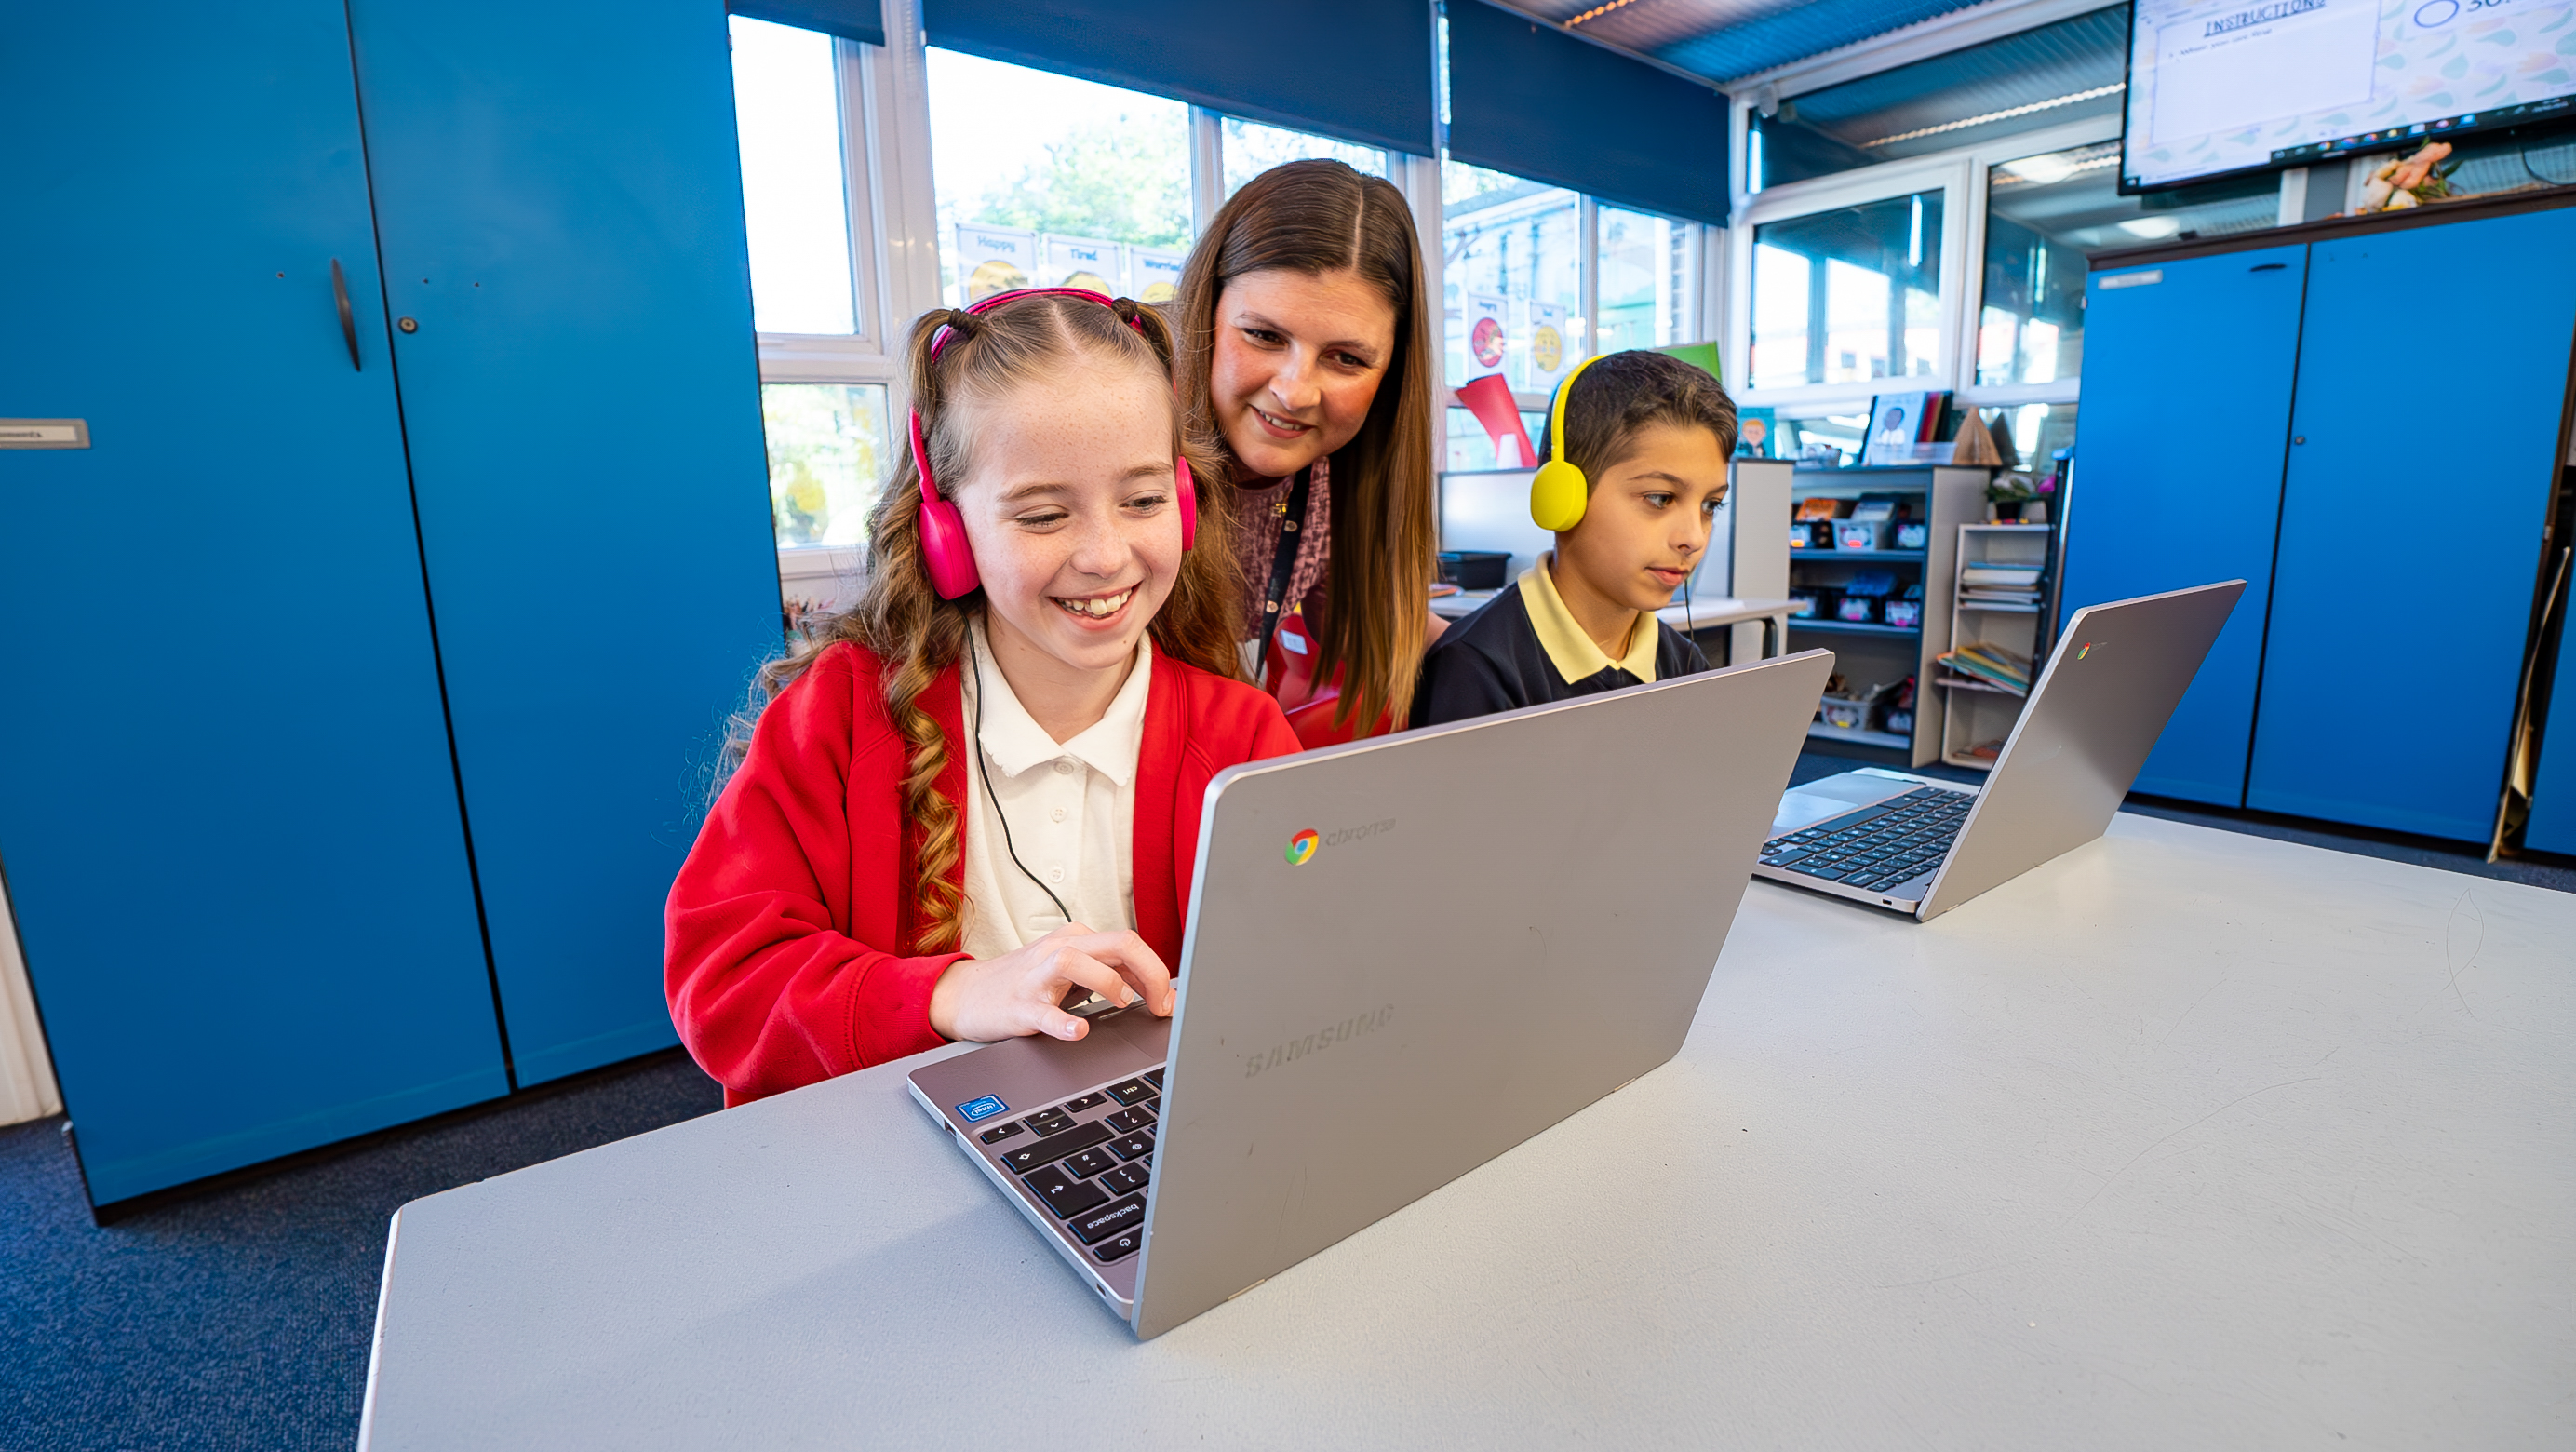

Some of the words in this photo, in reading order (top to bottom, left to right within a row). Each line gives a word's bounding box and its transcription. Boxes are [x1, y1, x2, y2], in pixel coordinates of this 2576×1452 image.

[977, 235, 1015, 252] Happy
[1071, 248, 1097, 261] Tired
[1122, 1085, 1138, 1095] ctrl
[1087, 1203, 1140, 1229] backspace
